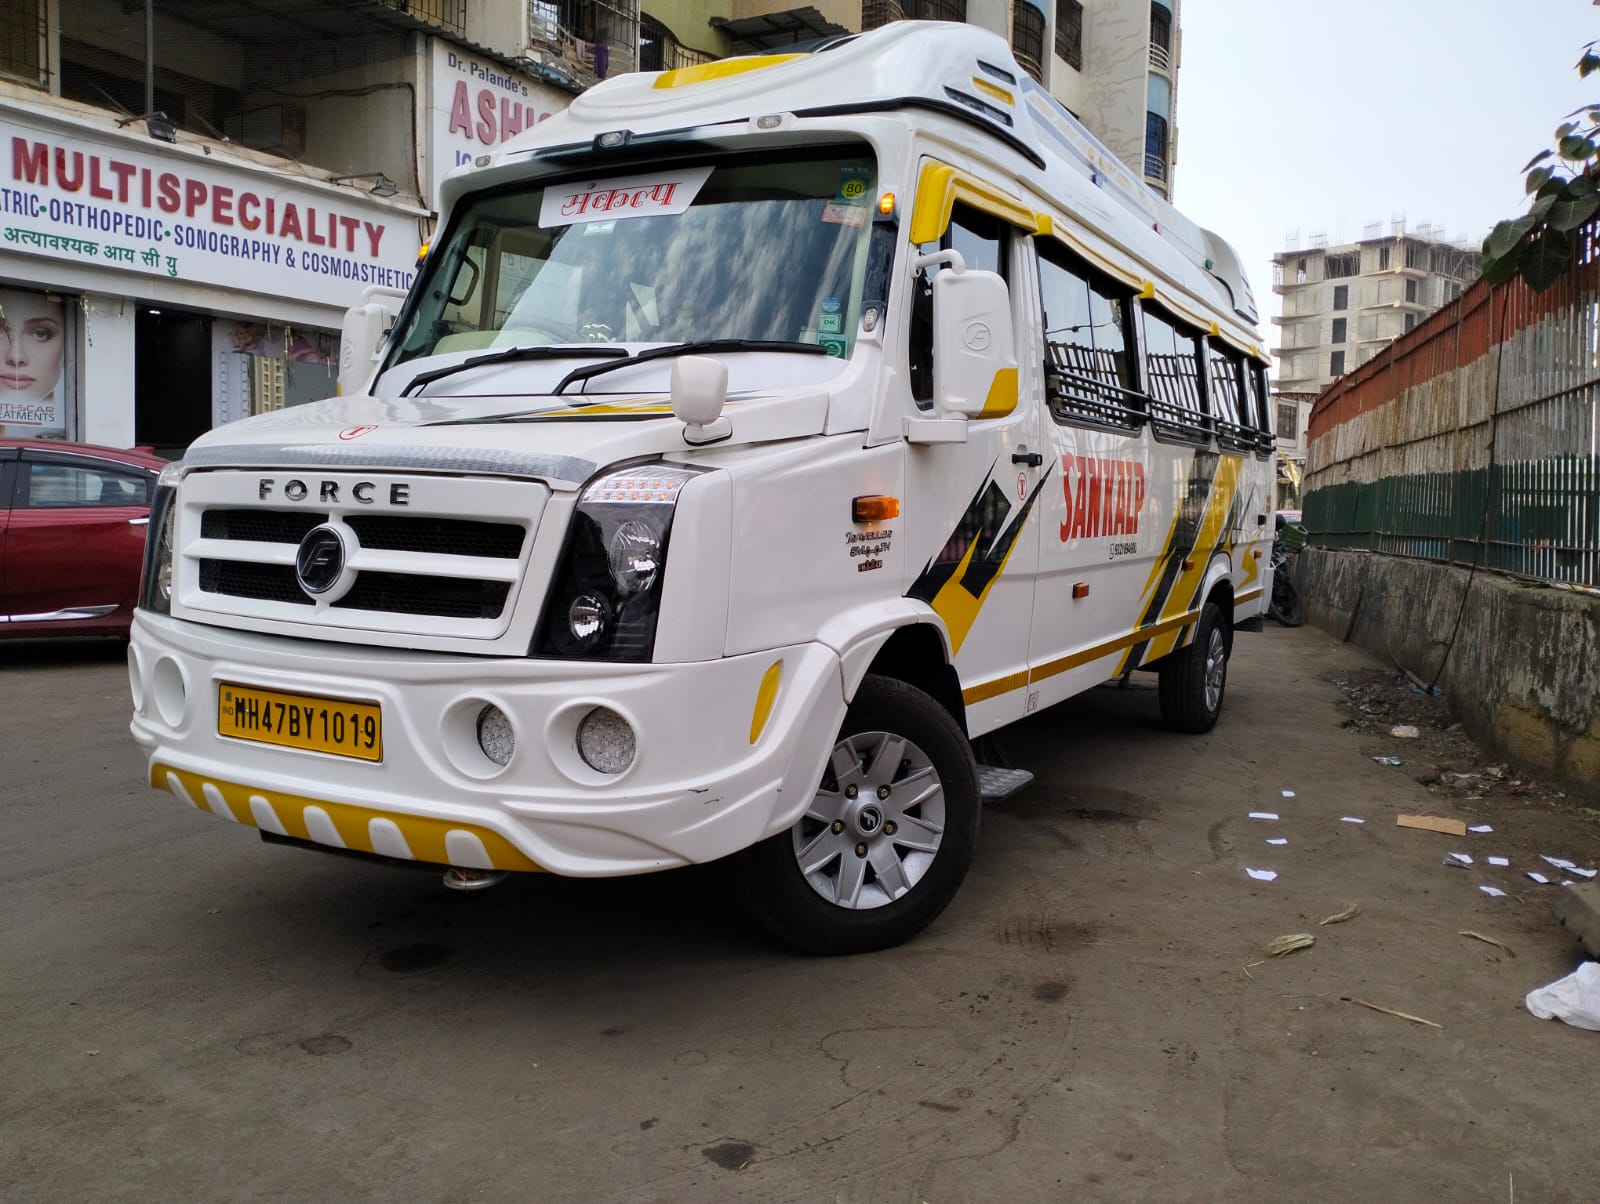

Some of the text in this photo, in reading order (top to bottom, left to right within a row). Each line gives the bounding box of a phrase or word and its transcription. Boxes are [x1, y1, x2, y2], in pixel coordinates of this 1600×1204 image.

[447, 52, 529, 97] Dr. Palande's
[449, 79, 553, 146] ASHI
[11, 136, 387, 258] MULTISPECIALITY
[846, 183, 863, 194] 80
[0, 188, 414, 291] TRIC ORTHOPEDIC SONOGRAPHY & COSMOASTHETIC
[3, 226, 179, 277] अत्यावश्यक आय सी यु
[258, 478, 412, 507] FORCE
[1059, 452, 1146, 543] SANKALP
[222, 705, 234, 716] IND
[234, 696, 376, 749] MH47BY1019
